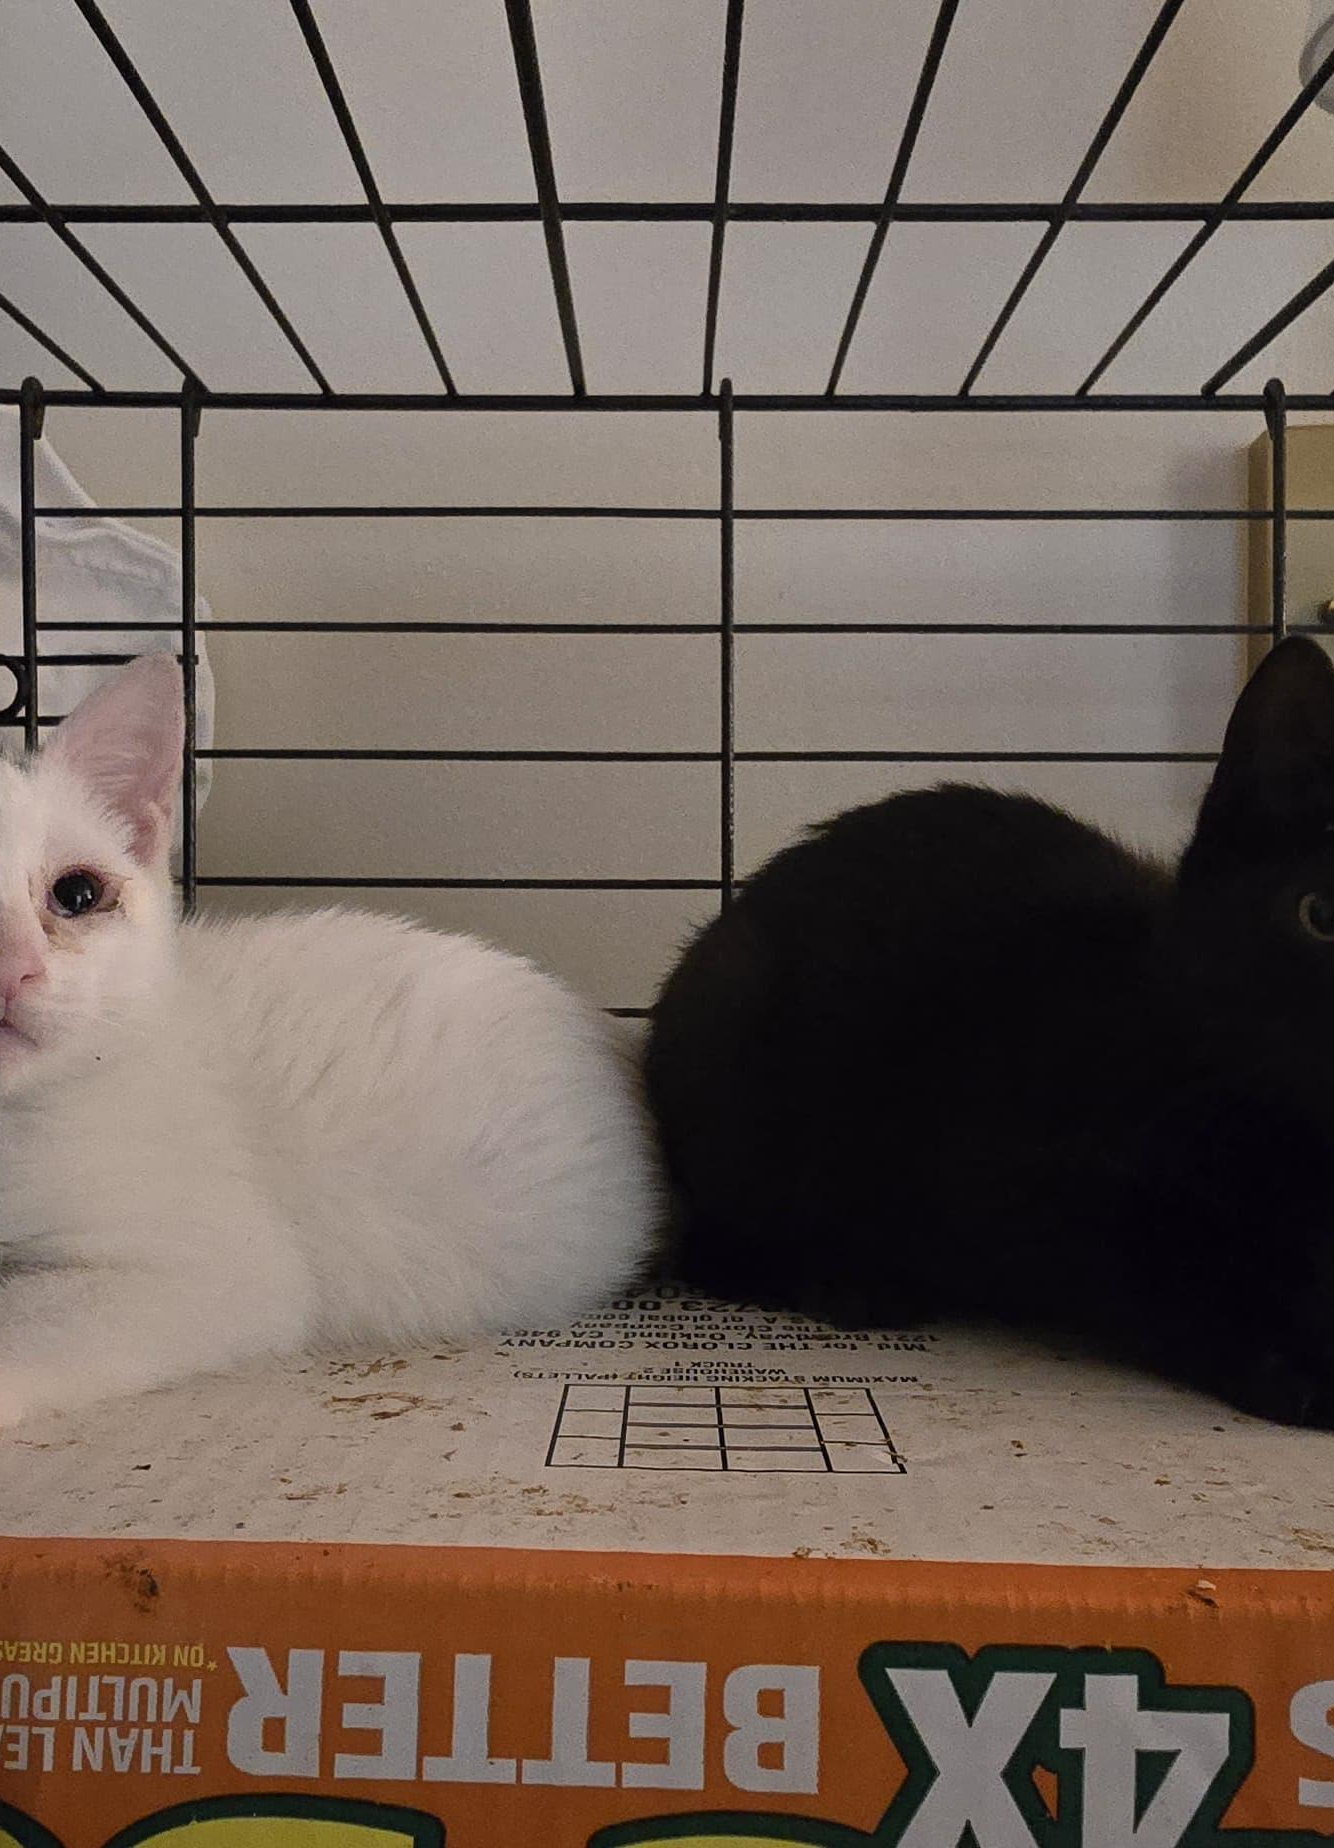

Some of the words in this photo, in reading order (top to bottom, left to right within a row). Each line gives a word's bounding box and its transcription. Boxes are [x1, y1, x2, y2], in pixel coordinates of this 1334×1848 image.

[639, 1314, 712, 1322] global
[570, 1321, 684, 1330] Company
[694, 1324, 773, 1332] Clorox
[571, 1330, 604, 1339] CA
[881, 1334, 942, 1342] 1221
[498, 1339, 634, 1349] COMPANY
[645, 1341, 753, 1351] CLOROX
[762, 1342, 813, 1351] THE
[821, 1342, 858, 1351] for
[866, 1342, 927, 1351] Mfd.
[659, 1367, 786, 1375] WAREHOUSE
[513, 1371, 618, 1381] (PALLETS)
[624, 1372, 698, 1382] HEIGHT
[707, 1374, 806, 1383] STACKING
[812, 1375, 918, 1383] MAXIMUM
[66, 1641, 165, 1668] KITCHEN
[226, 1646, 820, 1795] BETTER
[72, 1725, 202, 1776] THAN
[884, 1666, 1230, 1848] 4X
